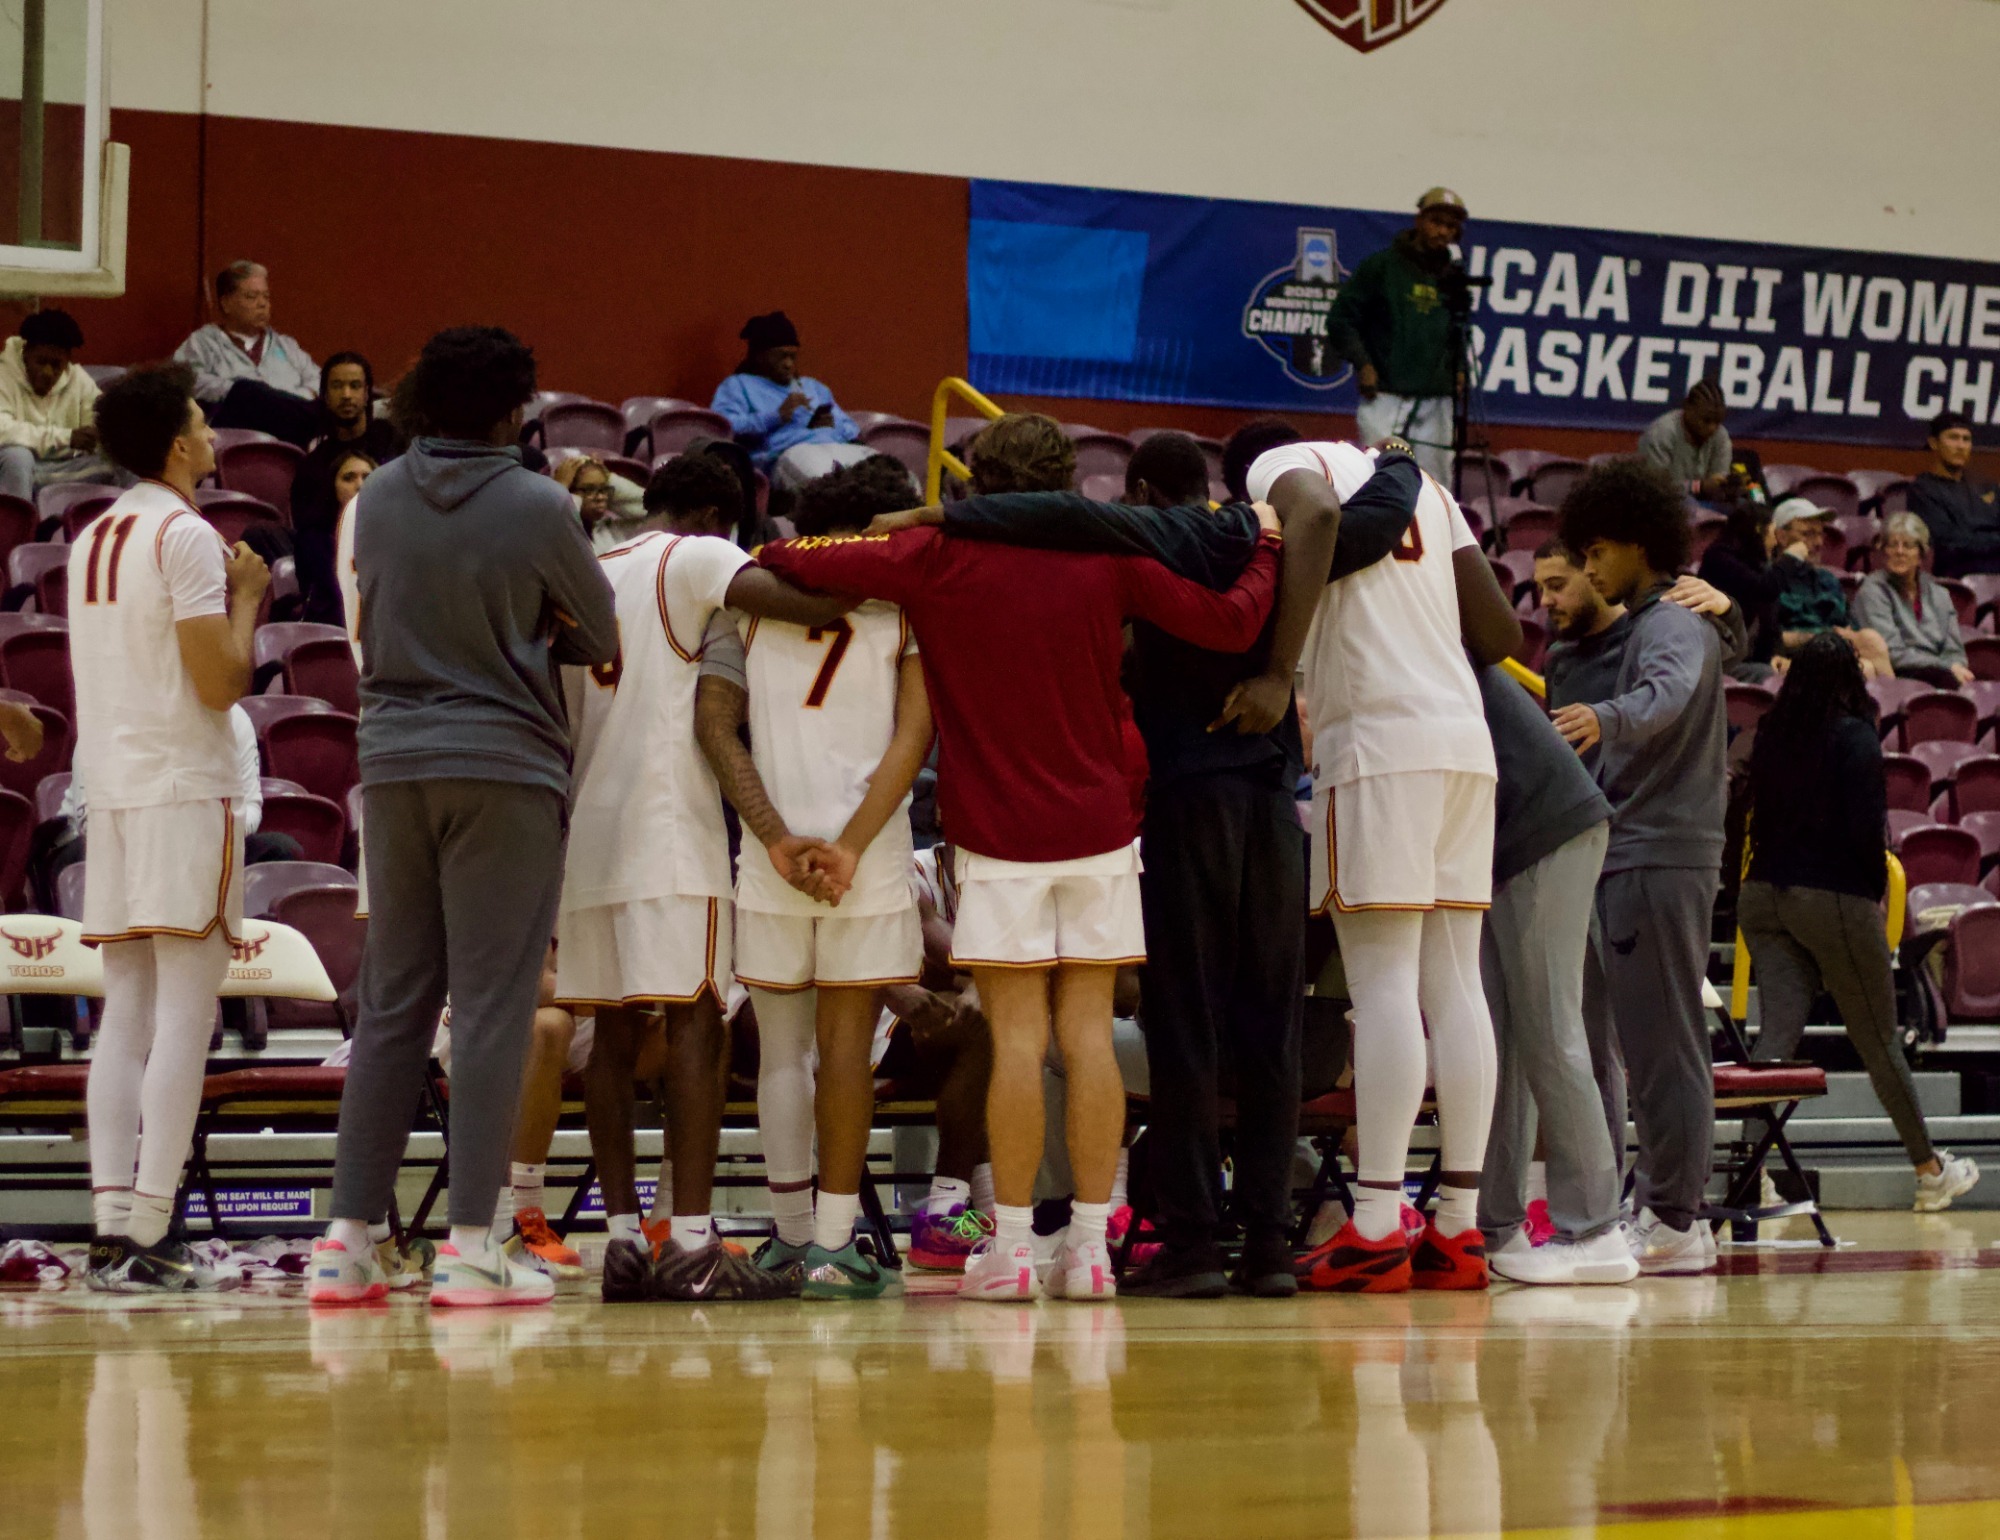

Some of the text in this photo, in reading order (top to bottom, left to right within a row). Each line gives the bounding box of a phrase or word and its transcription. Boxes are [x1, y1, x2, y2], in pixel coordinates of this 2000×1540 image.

[1660, 260, 1783, 334] DII
[1902, 355, 2000, 425] CH
[84, 513, 140, 605] 11
[802, 615, 855, 711] 7
[8, 964, 65, 977] TOROS
[226, 967, 272, 980] OROS
[229, 1191, 251, 1201] SEAT
[252, 1191, 272, 1201] WILL
[274, 1191, 285, 1200] BE
[287, 1190, 310, 1200] MADE
[235, 1202, 259, 1212] UPON
[261, 1201, 300, 1211] REQUEST
